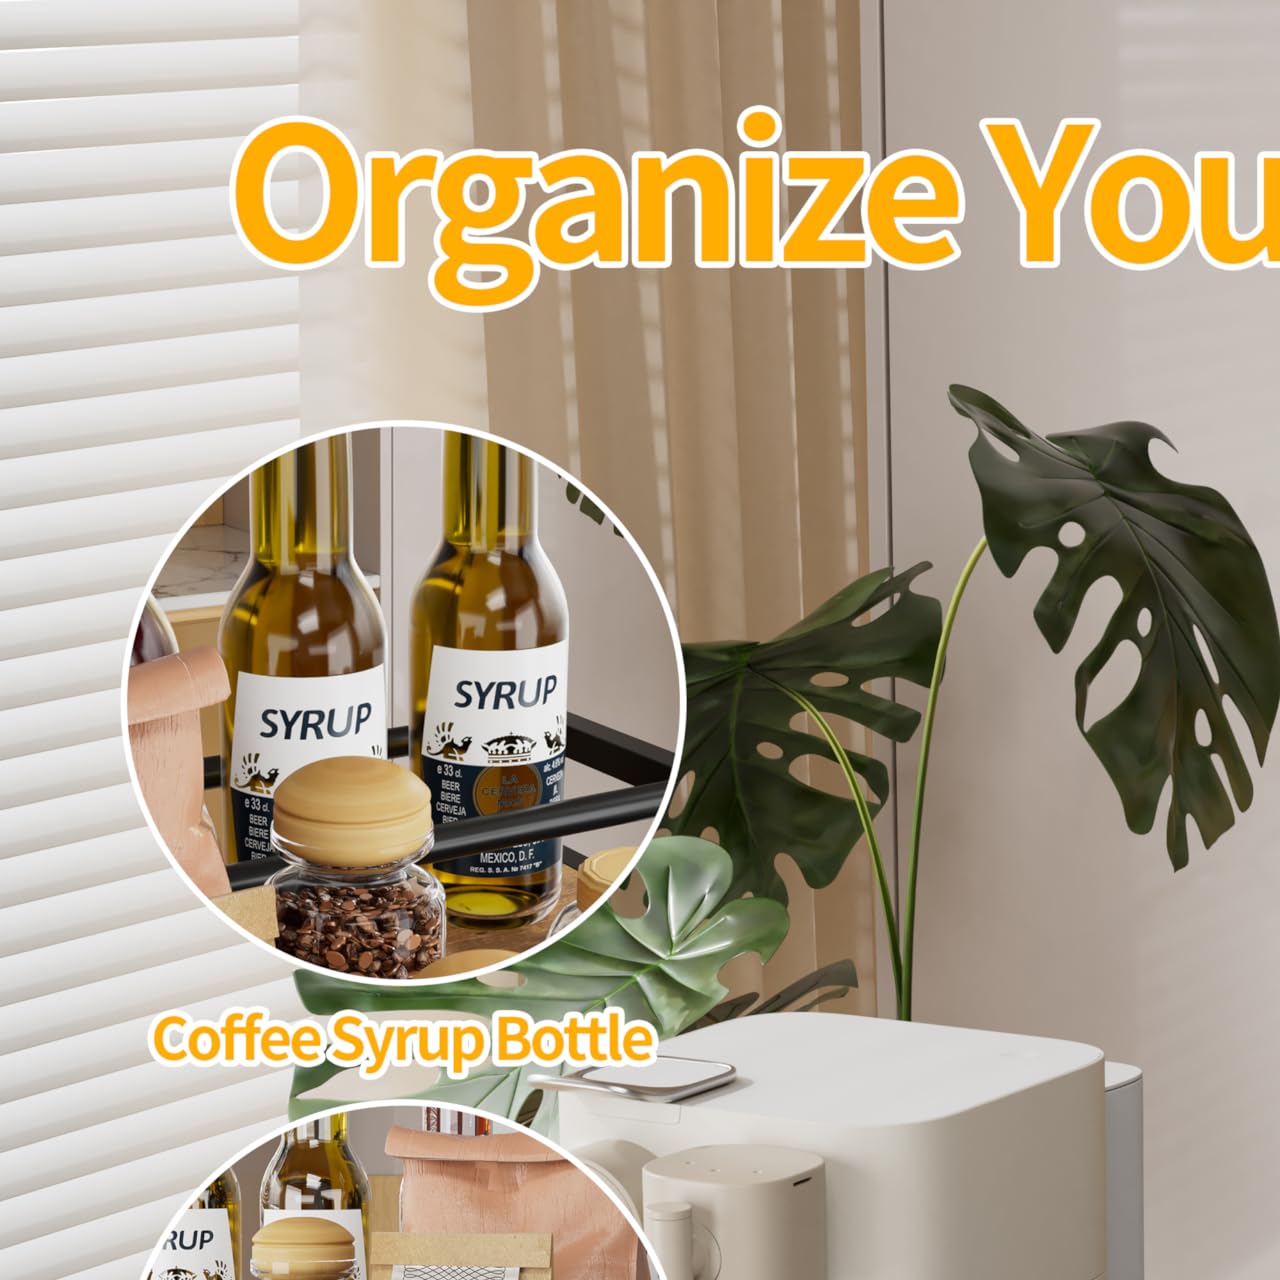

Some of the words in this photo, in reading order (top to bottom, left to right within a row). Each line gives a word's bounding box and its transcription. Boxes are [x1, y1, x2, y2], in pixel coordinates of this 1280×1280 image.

[454, 675, 557, 709] SYRUP
[260, 702, 372, 740] SYRUP
[444, 765, 453, 776] 33
[442, 780, 459, 791] BEER
[441, 792, 460, 803] BIERE
[250, 798, 261, 811] 33
[436, 805, 466, 816] CERVEJA
[249, 814, 267, 826] BEER
[249, 826, 269, 840] BIERE
[480, 852, 517, 863] MEXICO,
[519, 851, 527, 861] D.
[529, 849, 535, 859] F.
[163, 1230, 214, 1251] RUP
